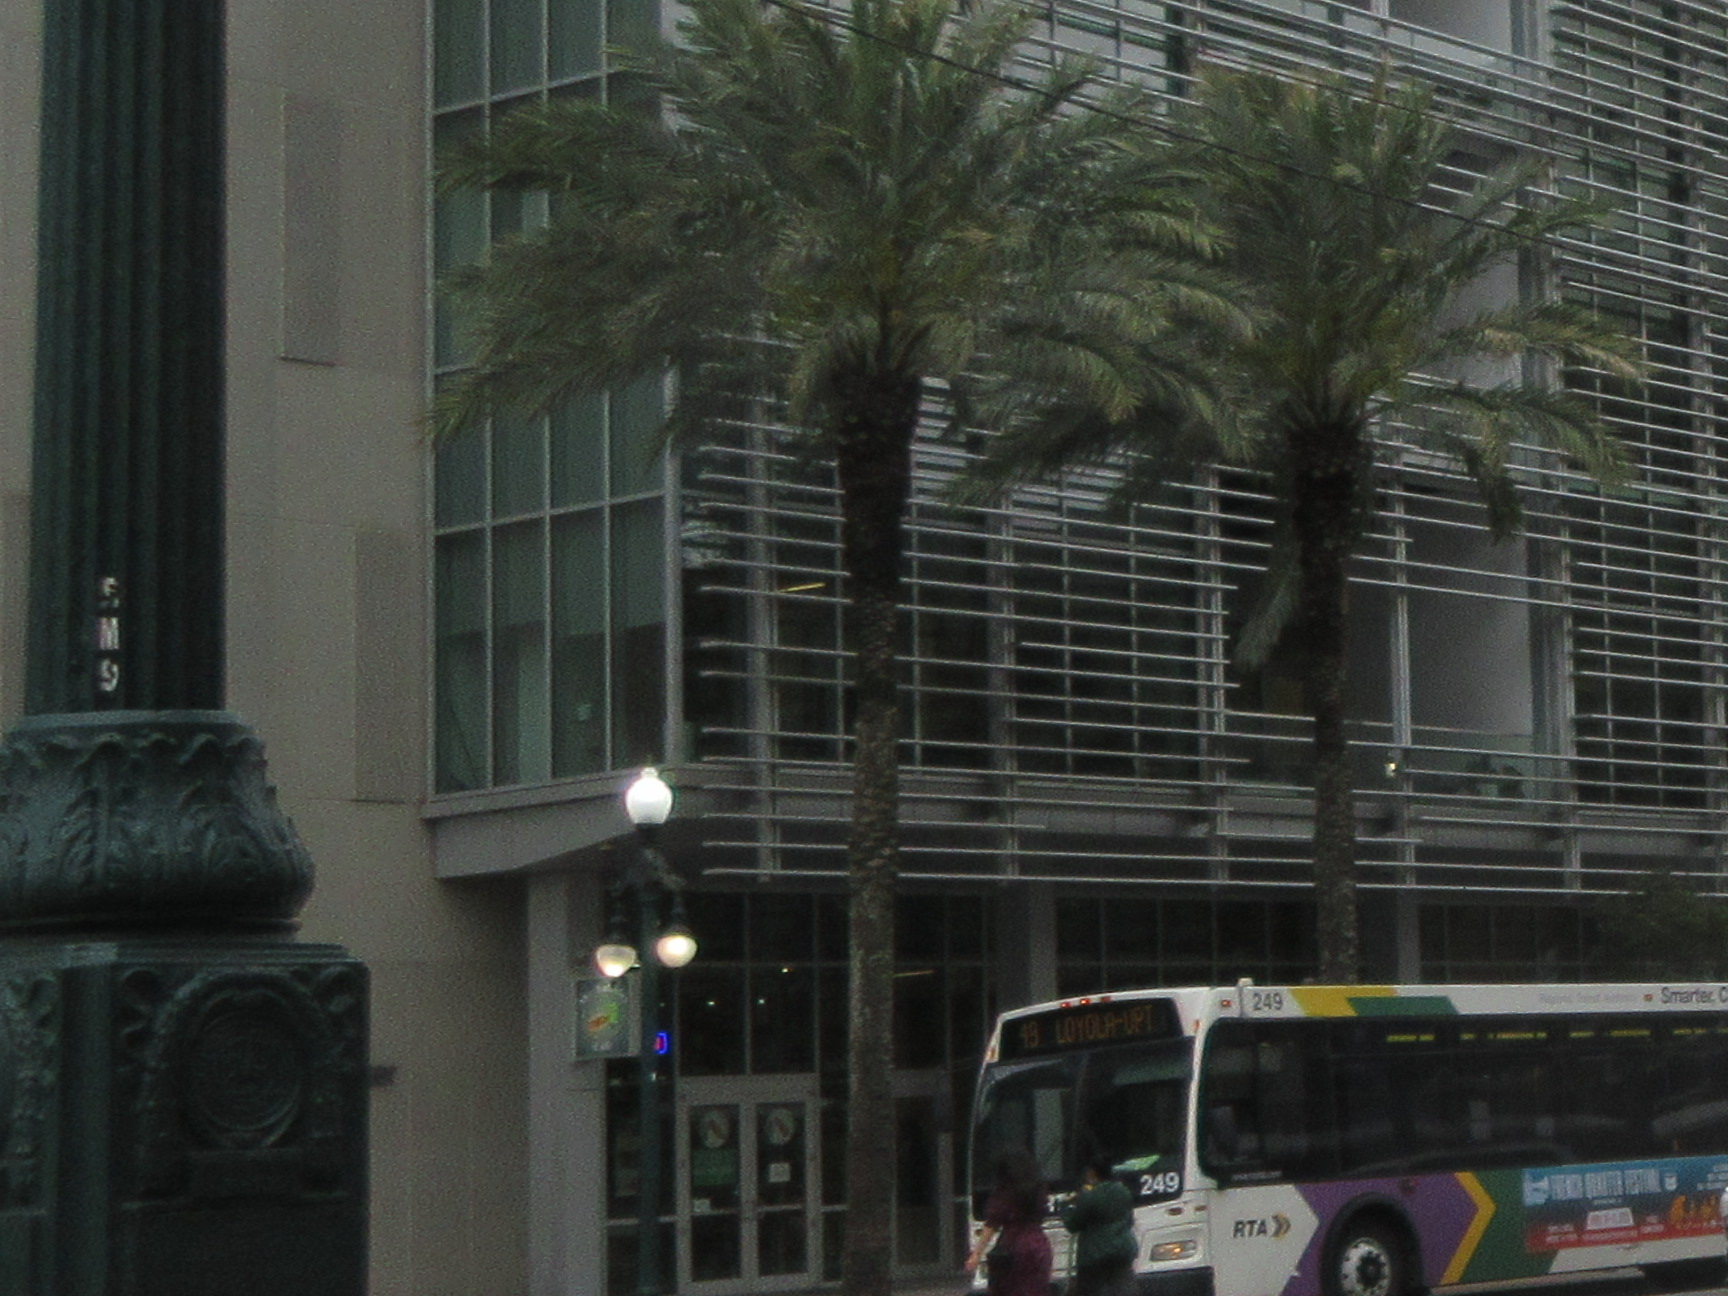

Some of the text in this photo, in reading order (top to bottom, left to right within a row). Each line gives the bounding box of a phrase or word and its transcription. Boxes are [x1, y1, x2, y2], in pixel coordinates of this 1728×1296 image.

[1252, 992, 1283, 1012] 249
[1139, 1172, 1181, 1196] 249
[1233, 1218, 1268, 1239] RTA
